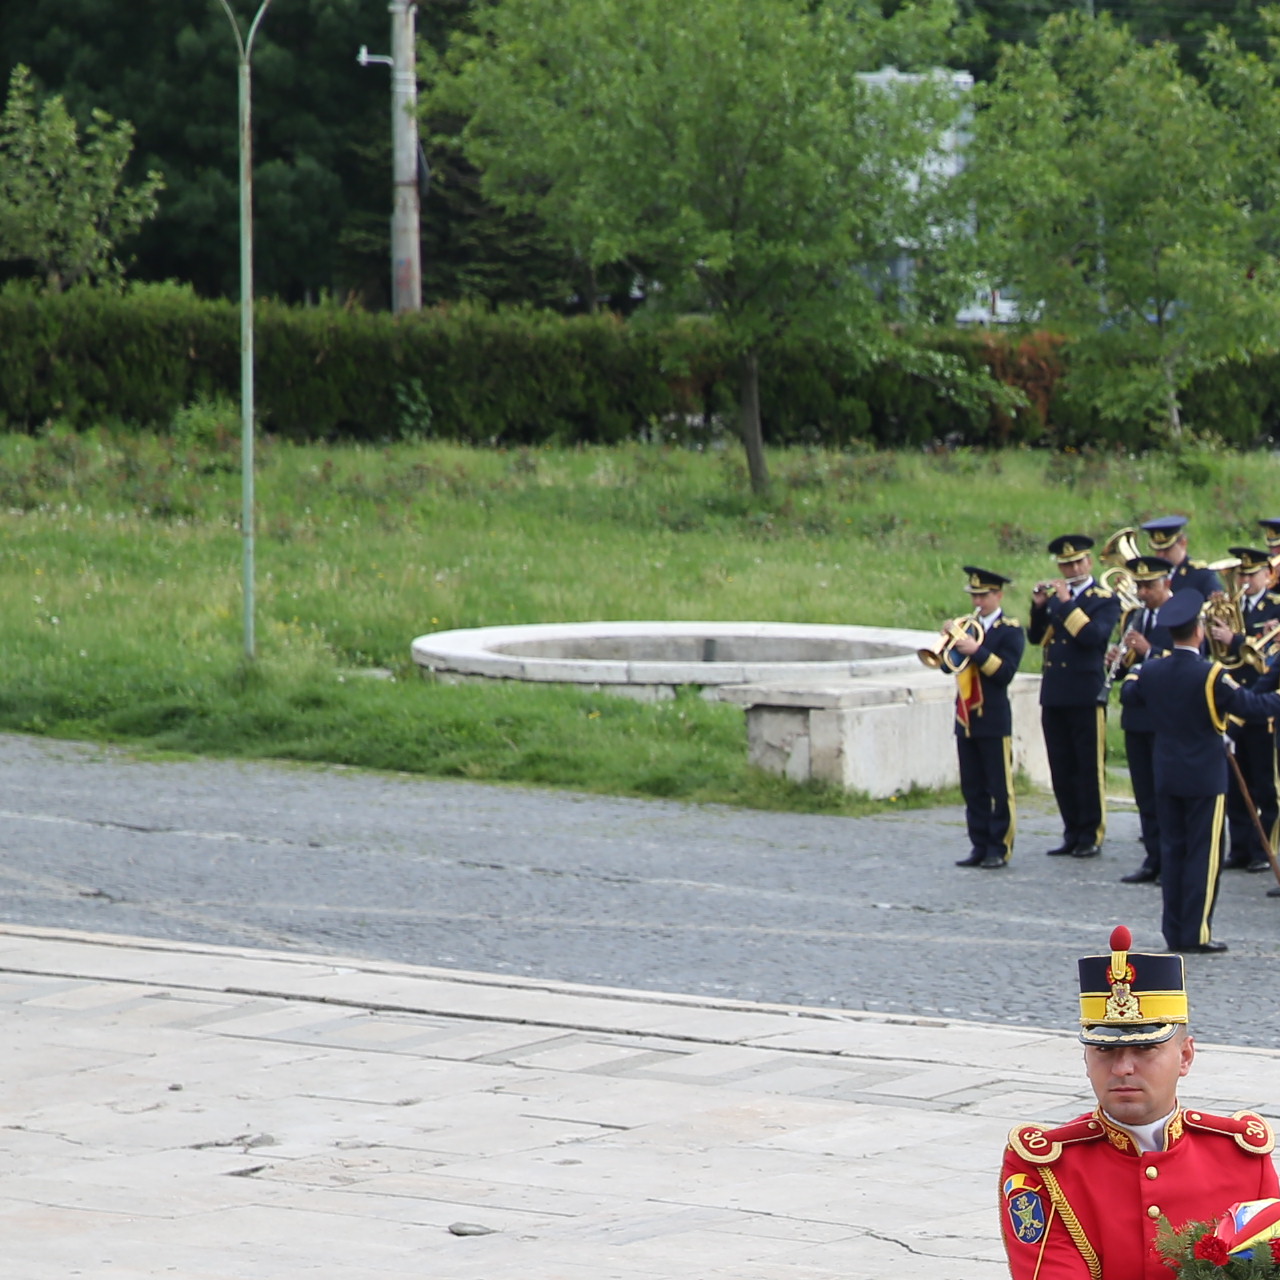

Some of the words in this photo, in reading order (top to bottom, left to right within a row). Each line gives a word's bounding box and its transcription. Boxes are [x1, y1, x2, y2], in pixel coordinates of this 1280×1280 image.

[1246, 1120, 1265, 1139] 30
[1023, 1130, 1048, 1149] 30
[1025, 1227, 1036, 1240] 30
